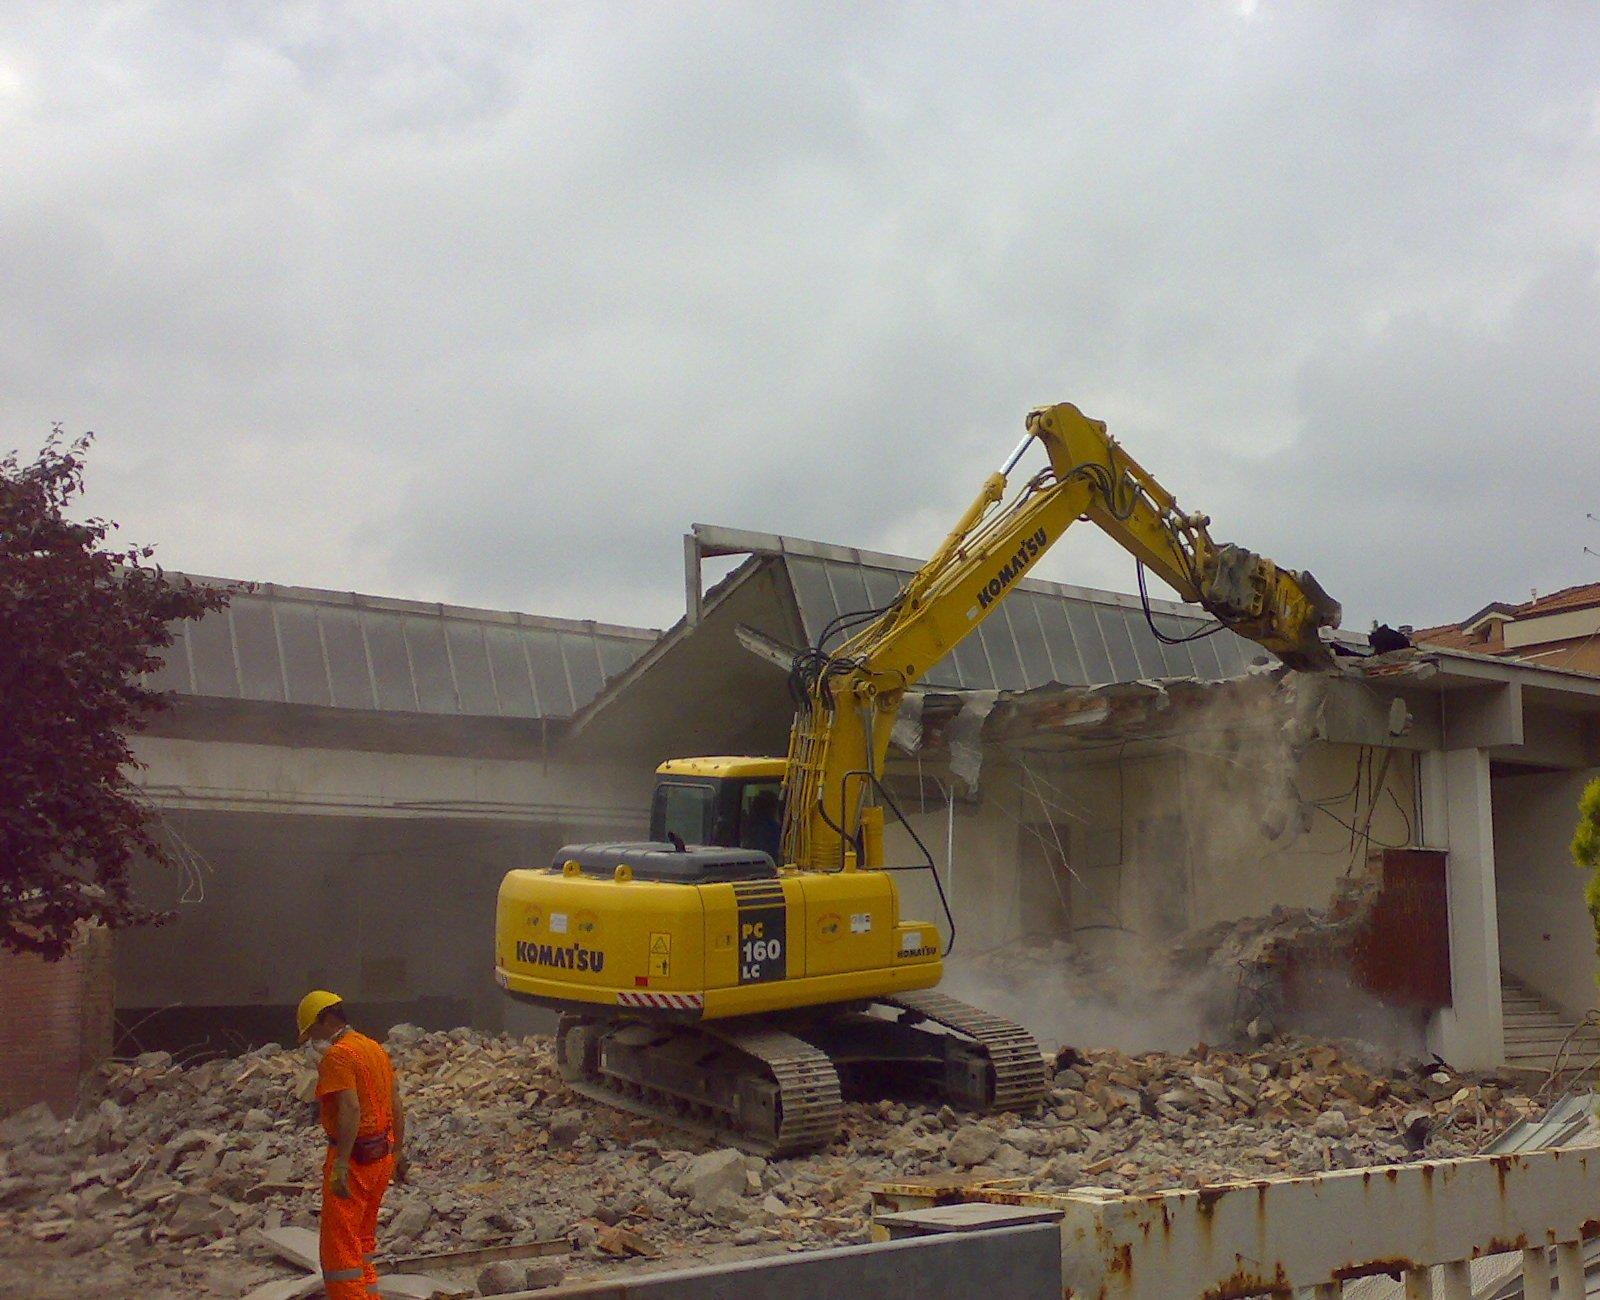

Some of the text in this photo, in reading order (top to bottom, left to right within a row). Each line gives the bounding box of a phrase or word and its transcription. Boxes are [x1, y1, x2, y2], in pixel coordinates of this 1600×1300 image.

[976, 527, 1047, 610] KOMATSU
[742, 922, 764, 939] PC
[516, 940, 604, 973] KOMATSU
[742, 939, 781, 962] 160
[896, 945, 937, 958] KOMATSU
[742, 964, 761, 979] LC
